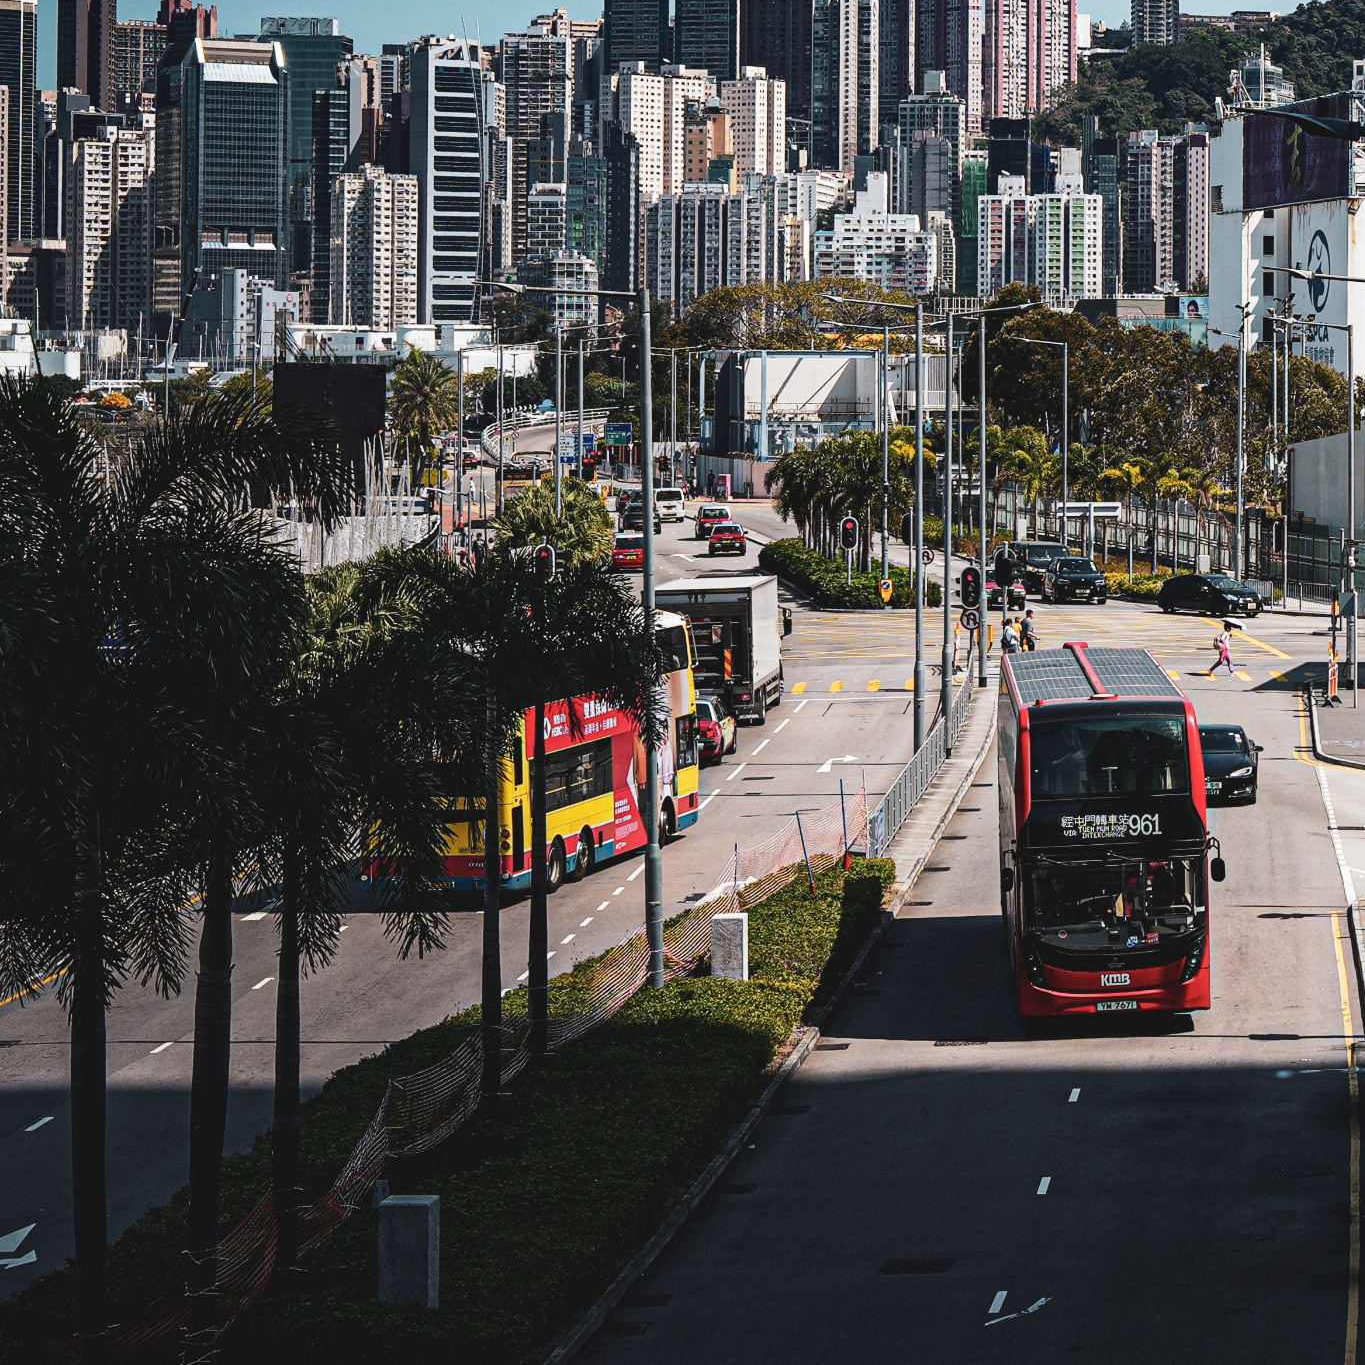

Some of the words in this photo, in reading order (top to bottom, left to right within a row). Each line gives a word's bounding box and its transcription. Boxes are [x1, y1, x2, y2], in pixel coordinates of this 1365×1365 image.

[1129, 814, 1162, 835] 961
[1101, 973, 1131, 986] KMB
[1115, 1001, 1133, 1009] 7671
